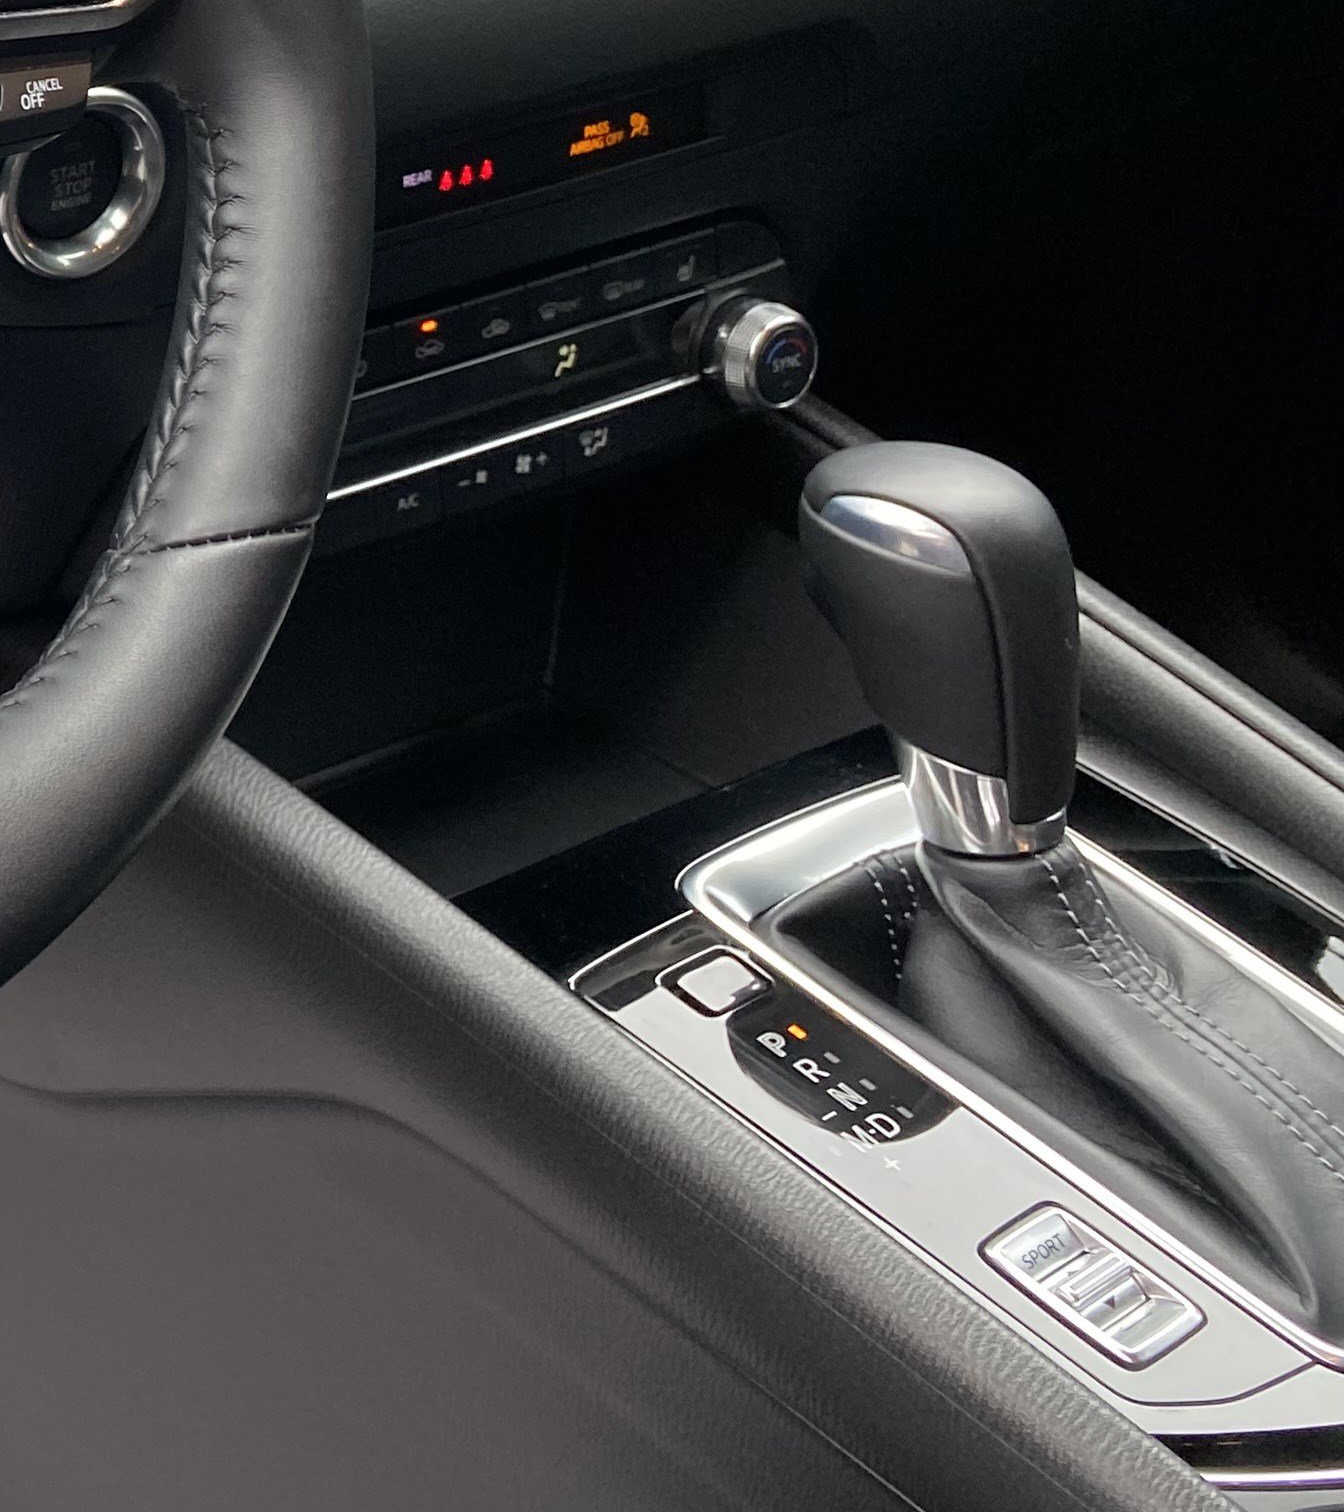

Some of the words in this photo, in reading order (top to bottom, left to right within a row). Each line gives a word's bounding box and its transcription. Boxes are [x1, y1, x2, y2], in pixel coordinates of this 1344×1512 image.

[26, 78, 63, 94] CANCEL
[20, 92, 46, 110] OFF
[755, 1031, 788, 1058] P
[792, 1057, 831, 1084] R
[826, 1081, 869, 1112] N
[1021, 1233, 1068, 1270] SPORT
